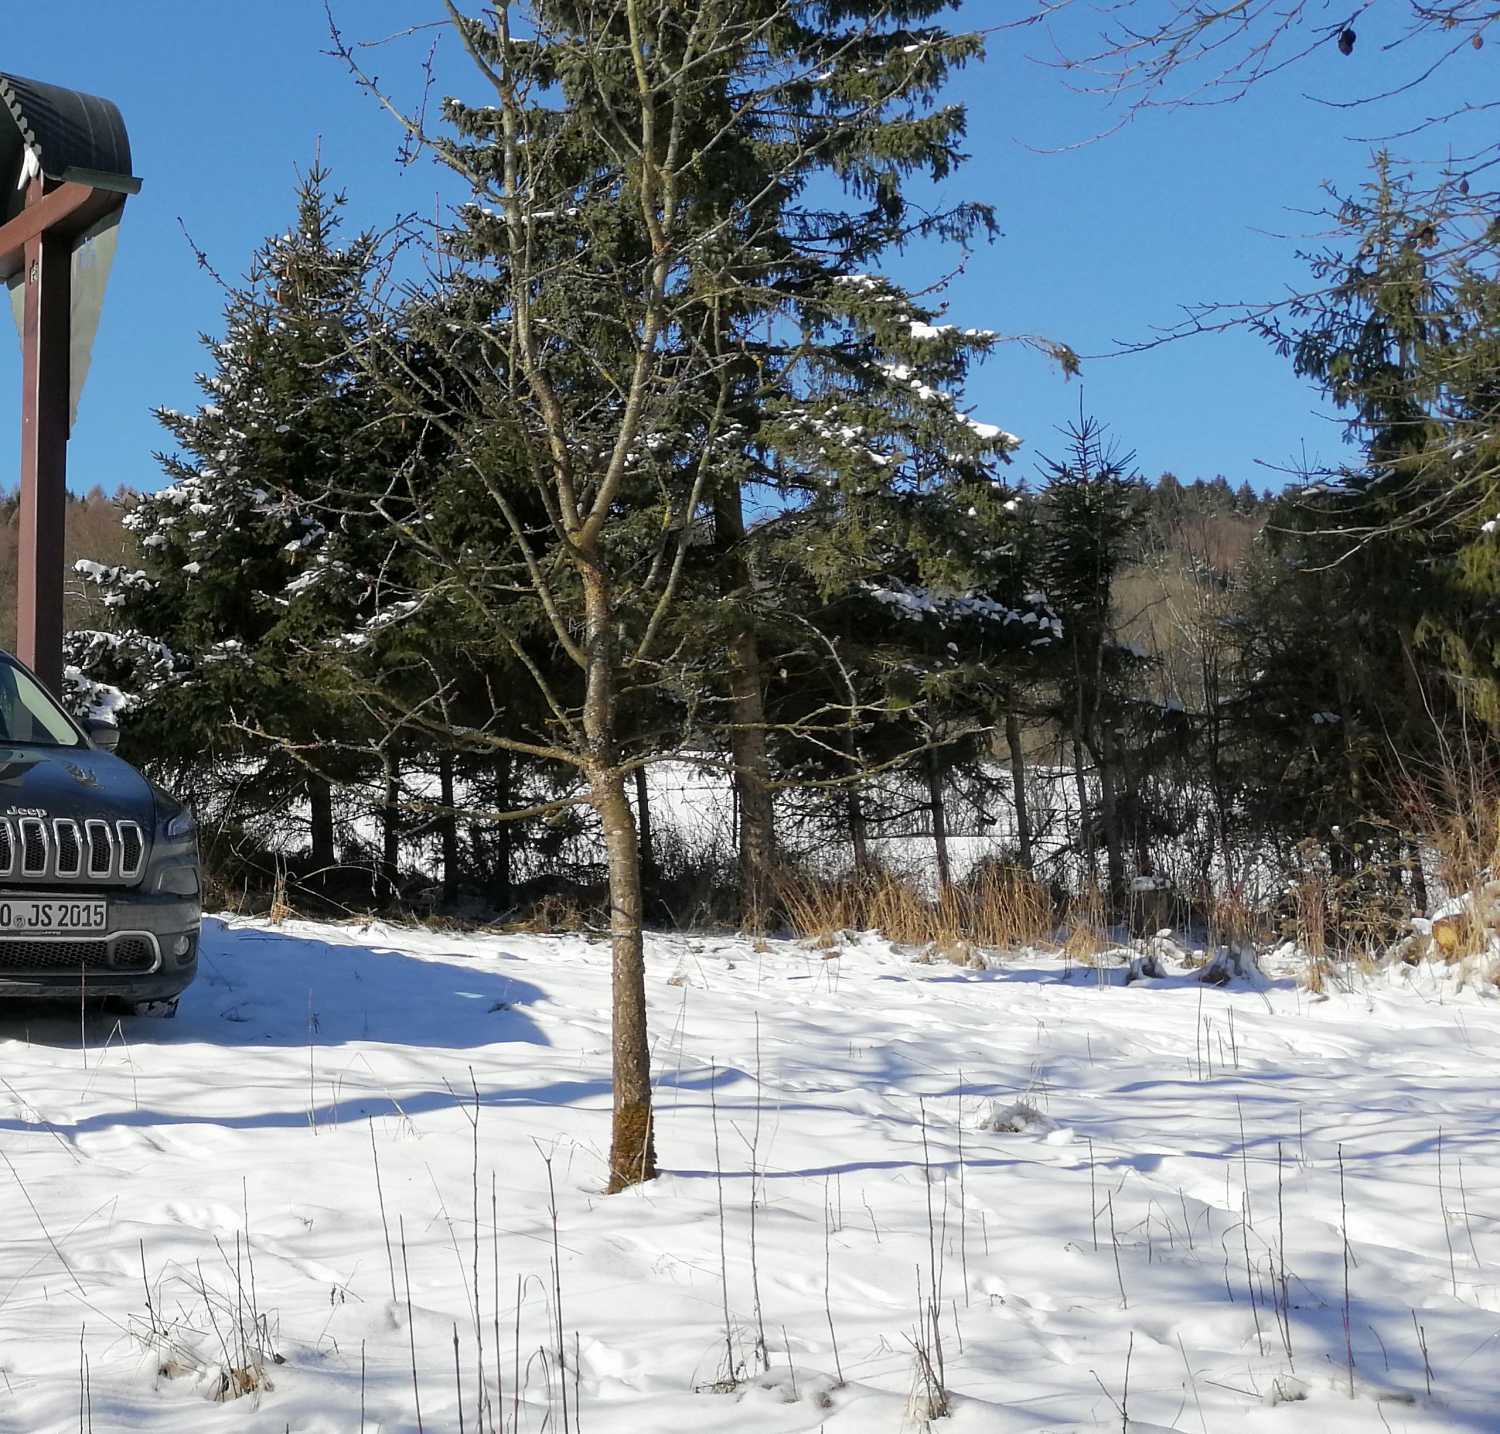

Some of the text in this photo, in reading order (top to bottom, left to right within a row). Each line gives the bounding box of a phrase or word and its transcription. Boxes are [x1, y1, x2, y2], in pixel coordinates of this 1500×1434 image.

[6, 805, 48, 818] Jeep
[27, 904, 53, 927] JS
[57, 904, 104, 927] 2015
